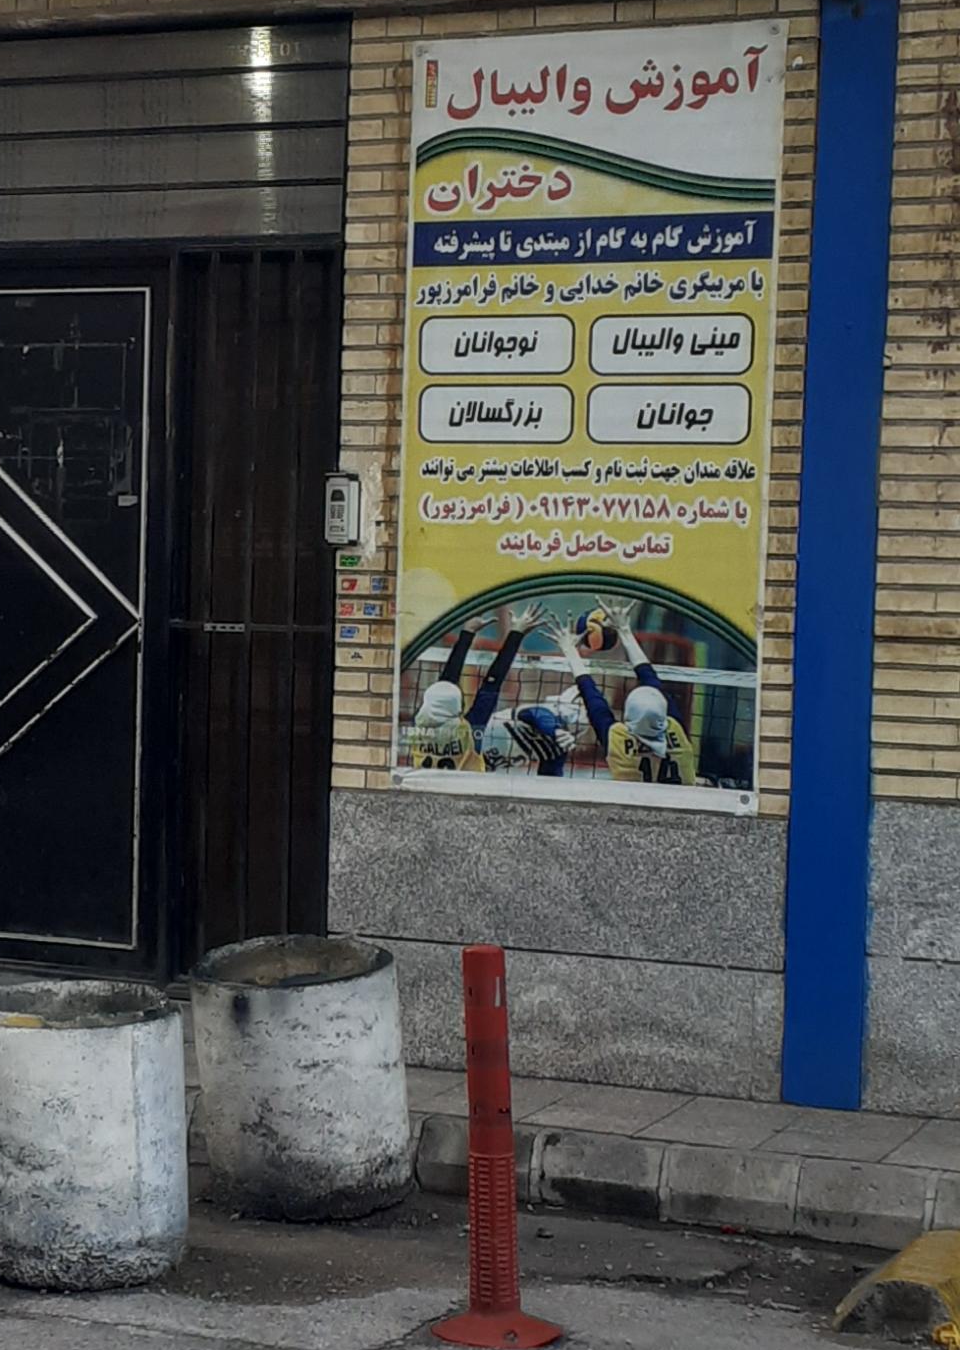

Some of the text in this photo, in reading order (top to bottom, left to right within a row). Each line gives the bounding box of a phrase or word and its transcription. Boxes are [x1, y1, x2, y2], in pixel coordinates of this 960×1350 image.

[446, 62, 592, 121] والیبال
[605, 44, 769, 116] آموزش
[427, 163, 572, 213] دختران
[433, 220, 757, 261] آموزش گام به گام از مبتدی تا پیشرفته
[416, 269, 764, 305] با مربیگری خانم خدایی و خانم فرامرزپور
[454, 330, 538, 360] نوجوانان
[612, 328, 740, 356] مینی والیبال
[448, 398, 543, 429] بزرگسالان
[636, 402, 714, 431] جوانان
[422, 458, 756, 484] علاقه مندان جهت ثبت نام و کسب اطلاعات بیشتر می توانند
[530, 497, 671, 518] ۰۹۱۴۳۰۷۷۱۵۸
[676, 500, 730, 524] شماره
[735, 501, 747, 524] با
[500, 532, 670, 558] تماس حاصل فرمایند
